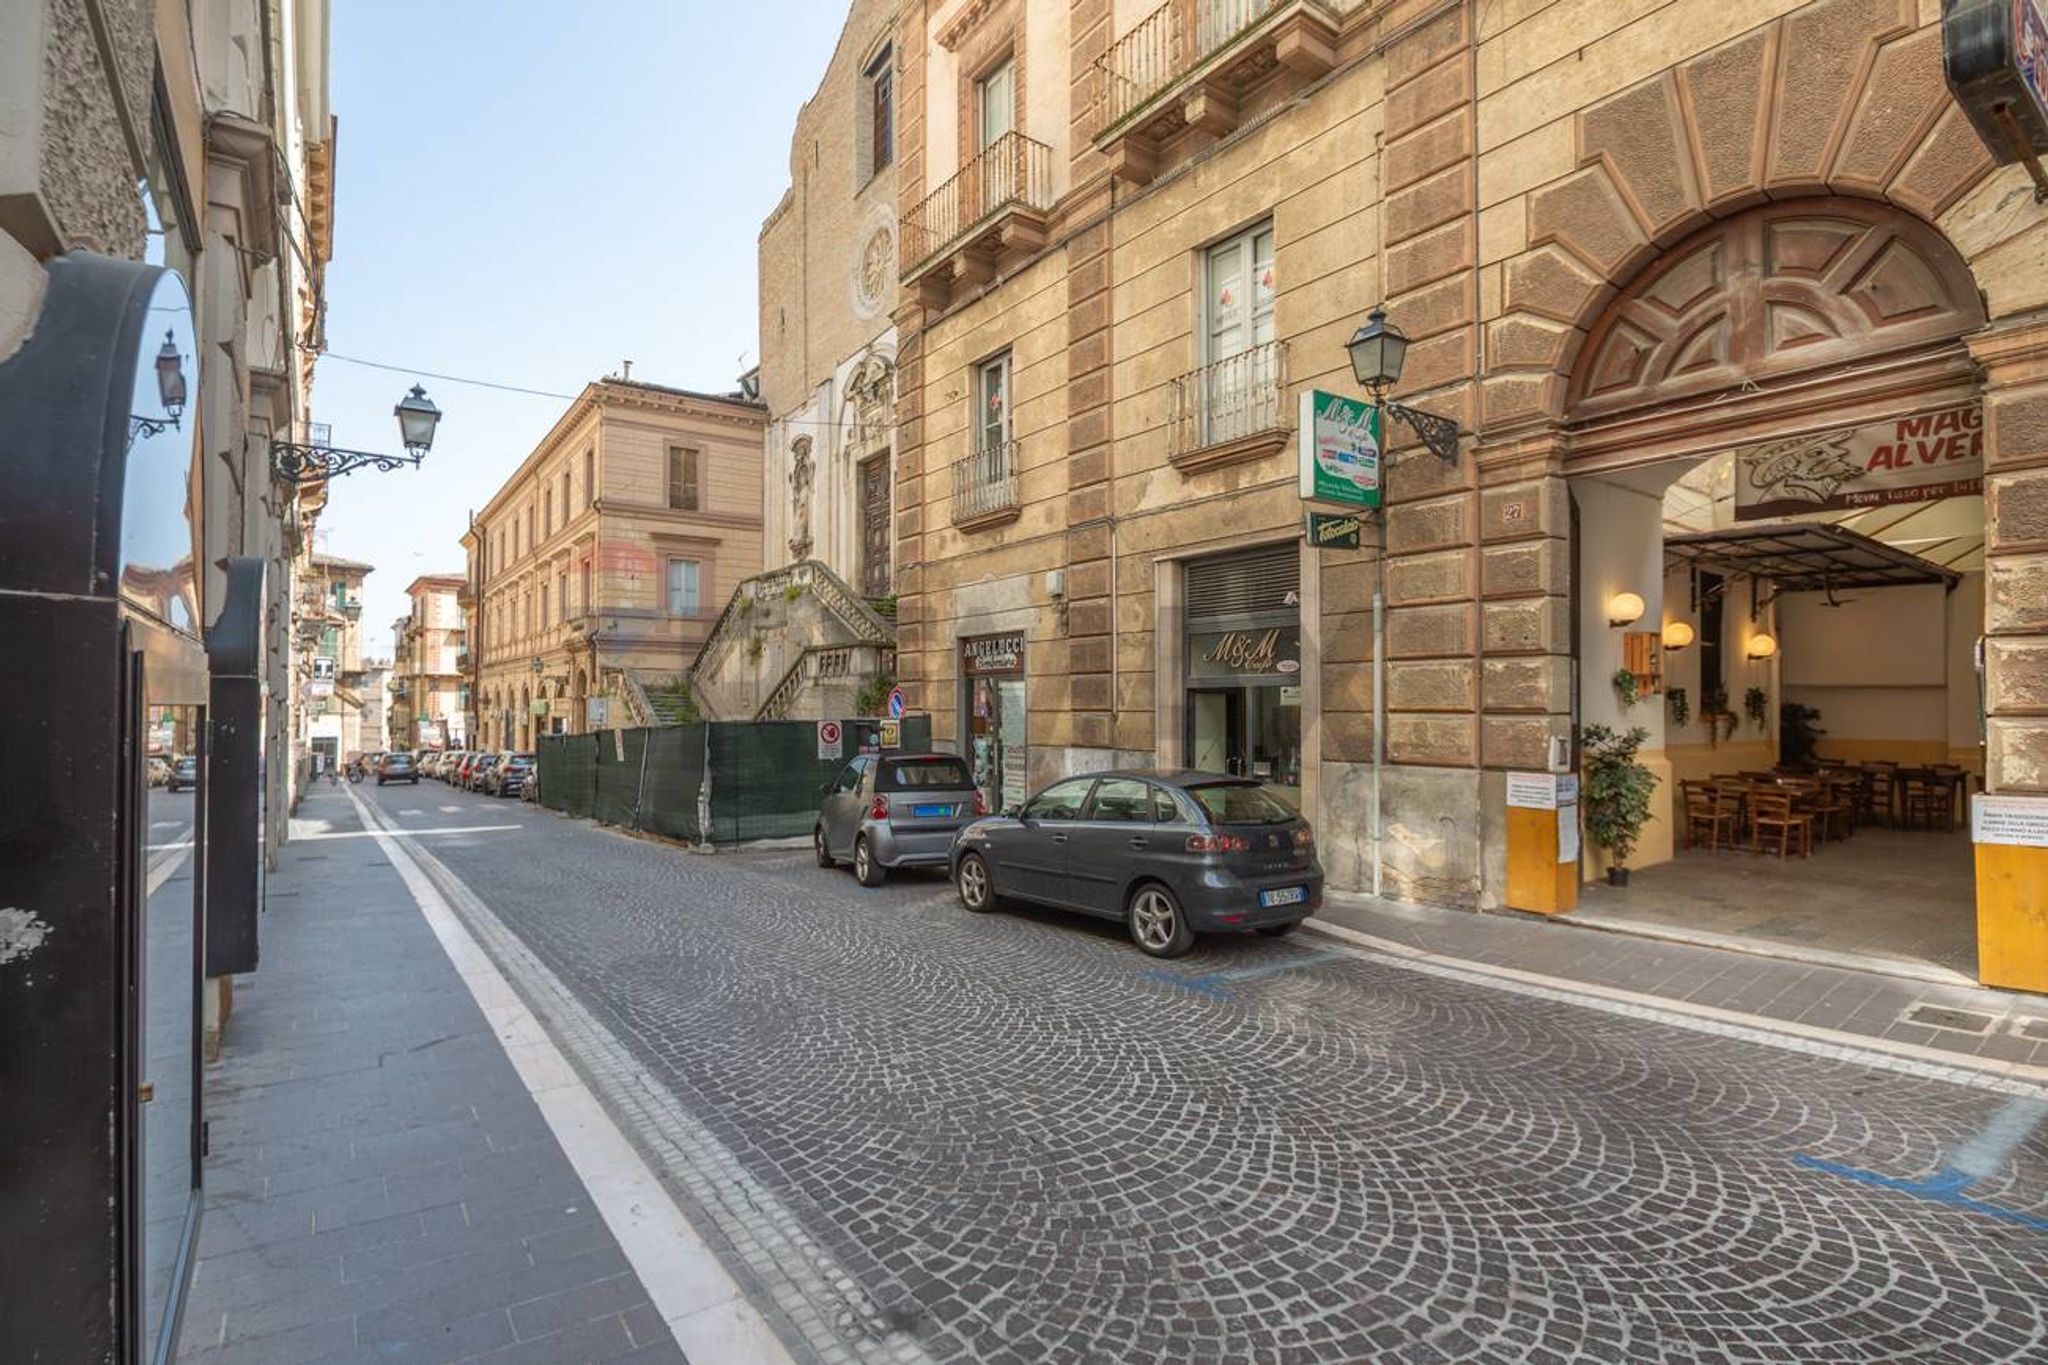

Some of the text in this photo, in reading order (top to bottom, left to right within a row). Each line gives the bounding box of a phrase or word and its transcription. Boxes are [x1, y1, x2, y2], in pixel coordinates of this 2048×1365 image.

[1317, 398, 1376, 434] M&M
[964, 636, 1024, 657] ANGELUCCI
[1202, 628, 1281, 668] M&M
